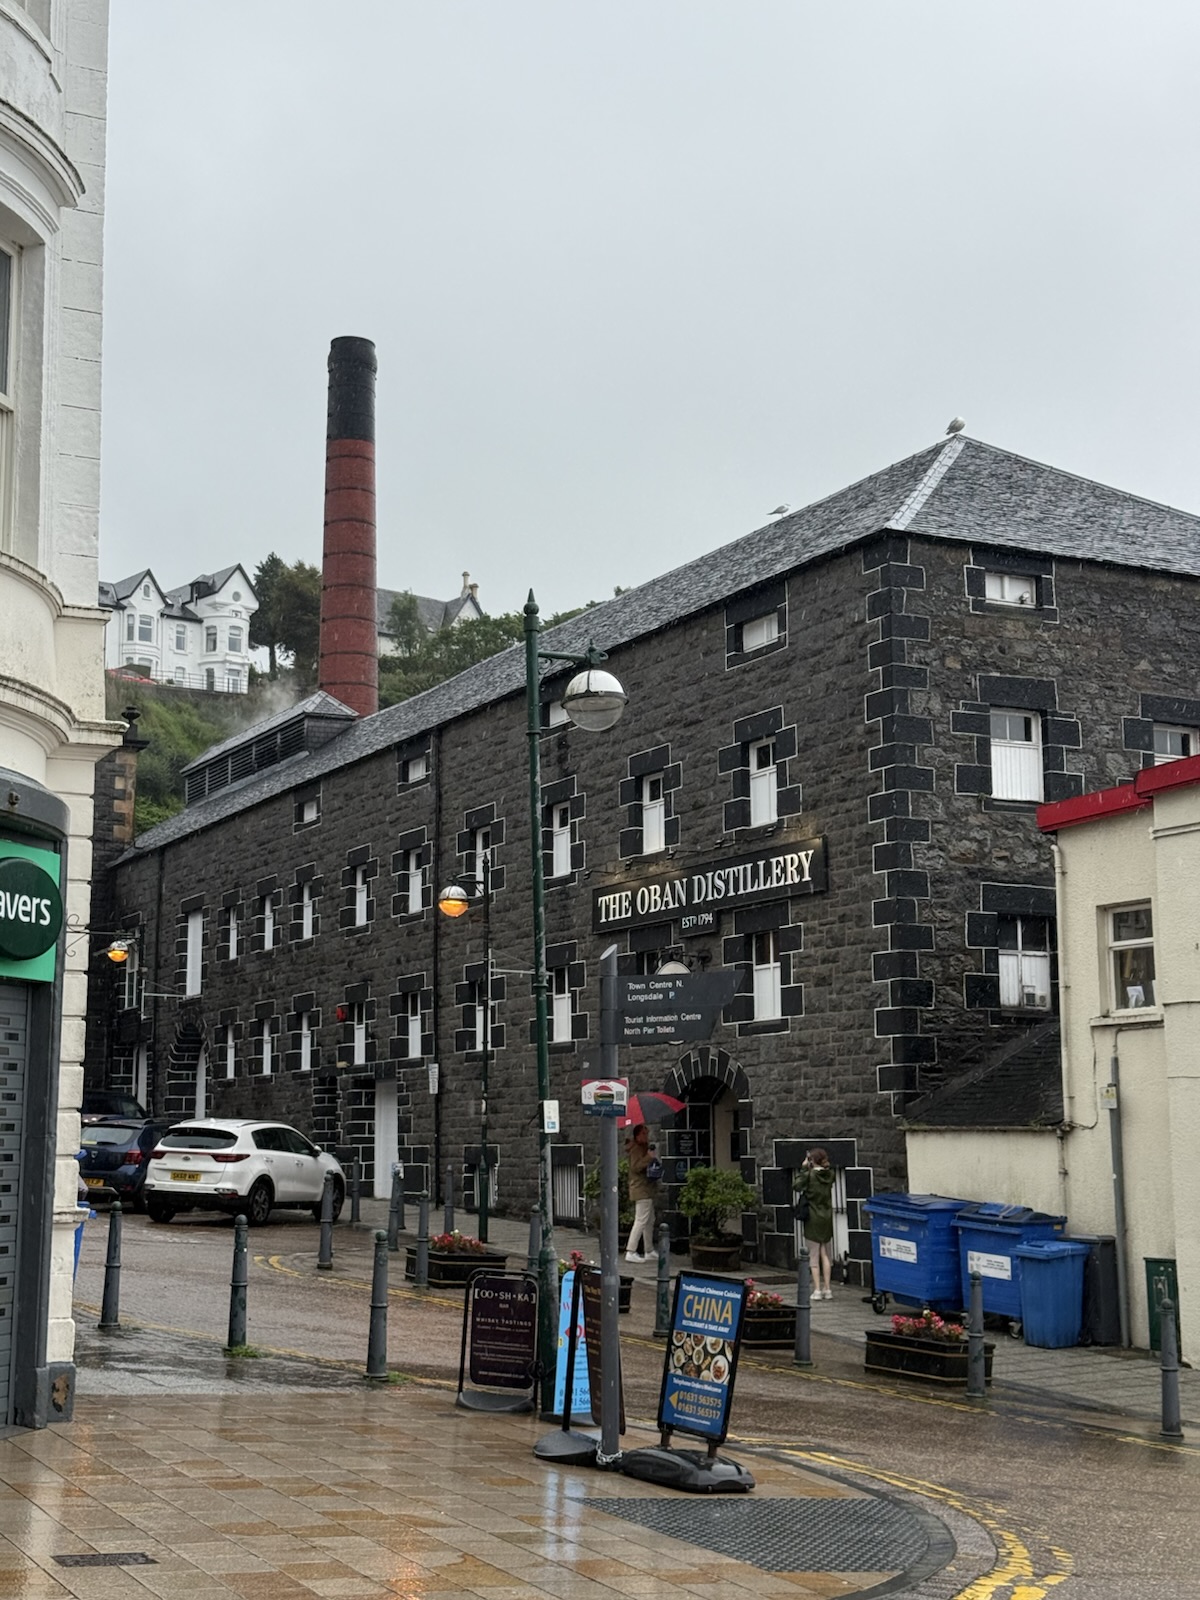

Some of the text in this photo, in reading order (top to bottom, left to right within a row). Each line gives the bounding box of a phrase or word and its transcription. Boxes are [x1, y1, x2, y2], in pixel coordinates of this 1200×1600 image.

[597, 849, 815, 923] THE OBAN DISTILLERY
[698, 912, 713, 926] 1794
[627, 982, 646, 990] Town
[649, 981, 673, 989] Centre
[627, 993, 663, 1002] Longsdale
[624, 1016, 643, 1024] Tourist
[646, 1014, 678, 1023] Information
[624, 1026, 675, 1035] North Pier Toilets
[583, 1090, 592, 1100] 13
[682, 1283, 741, 1299] Traditional Chinese Cuisine
[683, 1294, 732, 1325] CHINA
[476, 1317, 532, 1327] WHISKY TASTINGS
